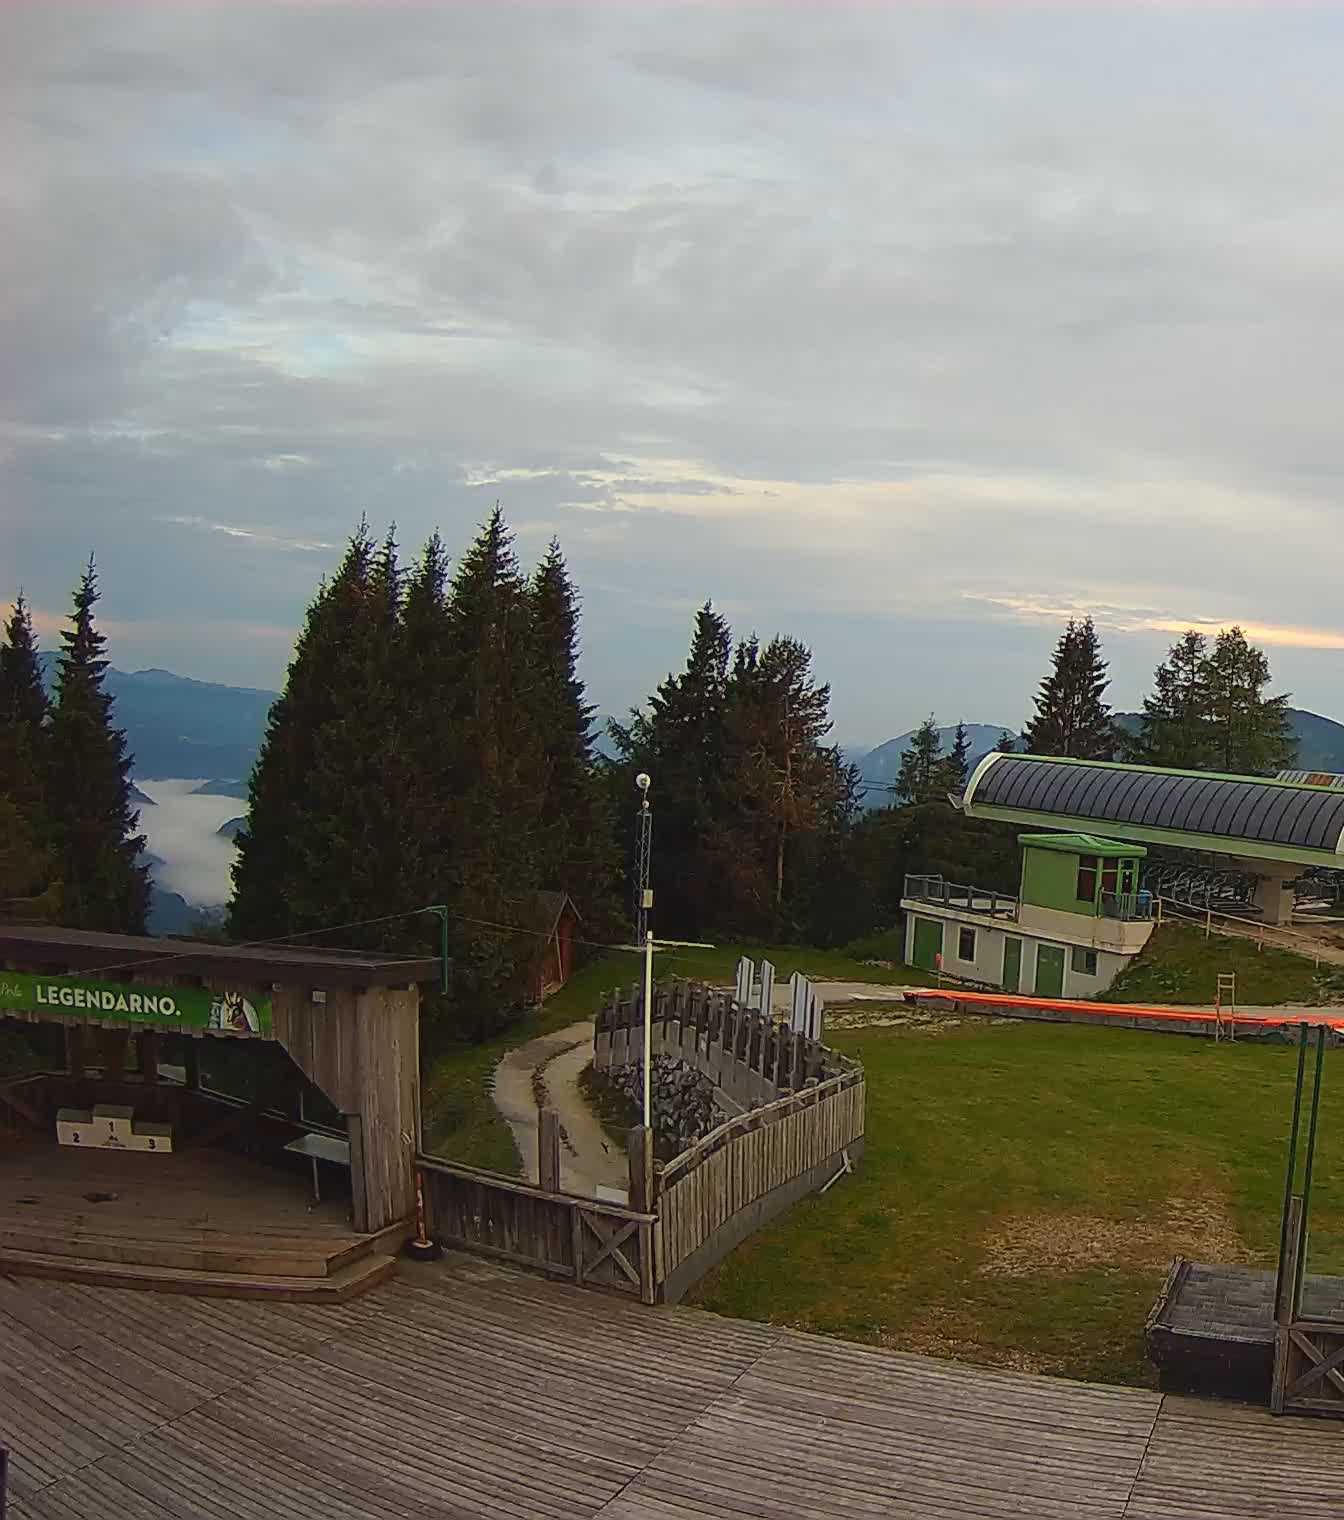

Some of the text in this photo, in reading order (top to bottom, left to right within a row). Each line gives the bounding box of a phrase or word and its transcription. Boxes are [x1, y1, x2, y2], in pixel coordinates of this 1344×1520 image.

[36, 984, 181, 1016] LEGENDARNO.
[109, 1121, 114, 1132] 1
[73, 1133, 80, 1143] 2
[148, 1139, 156, 1149] 3
